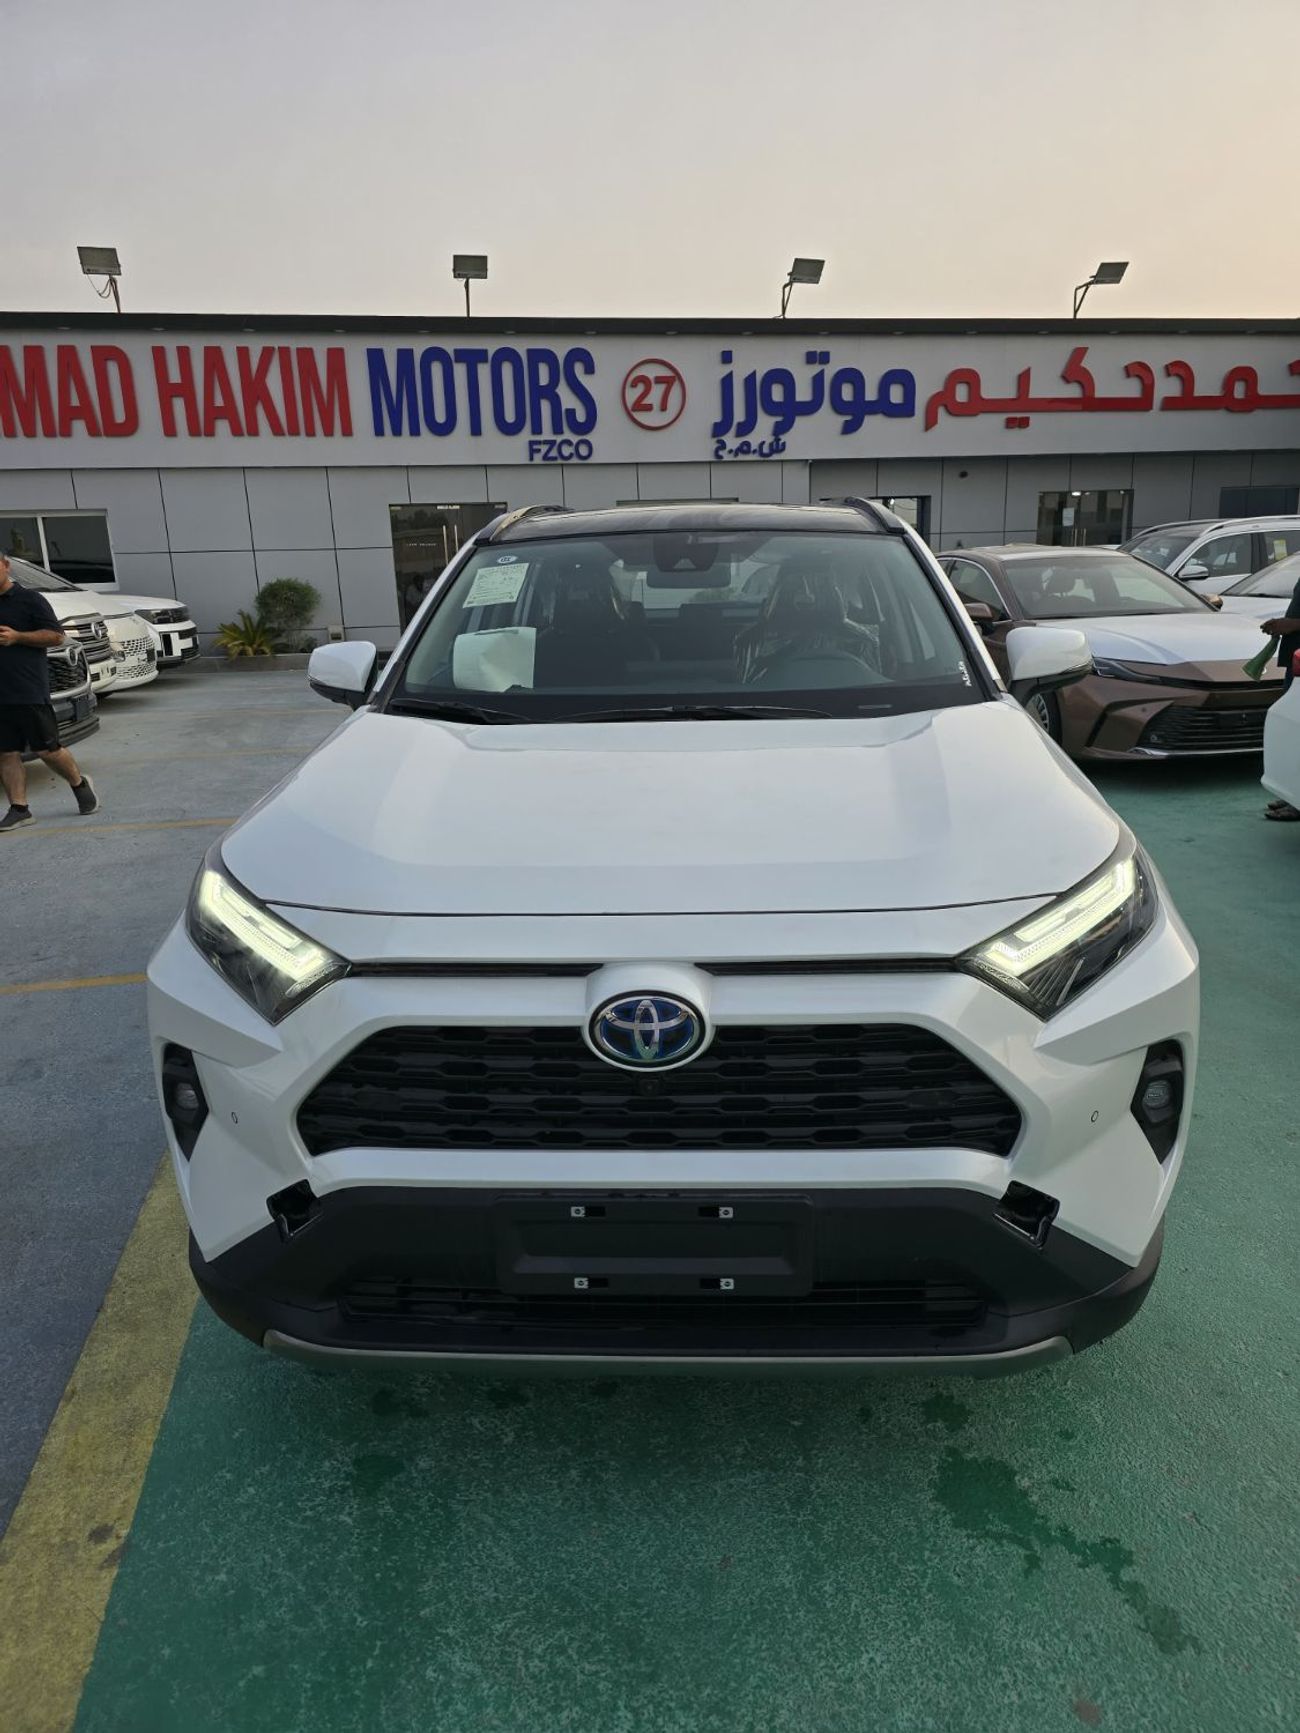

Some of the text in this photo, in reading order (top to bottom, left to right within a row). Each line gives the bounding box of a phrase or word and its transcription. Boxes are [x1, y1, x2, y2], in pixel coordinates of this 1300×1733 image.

[0, 345, 598, 438] MAD HAKIM MOTORS
[630, 374, 677, 413] 27
[711, 350, 917, 438] موتورز
[528, 438, 594, 462] FZCO
